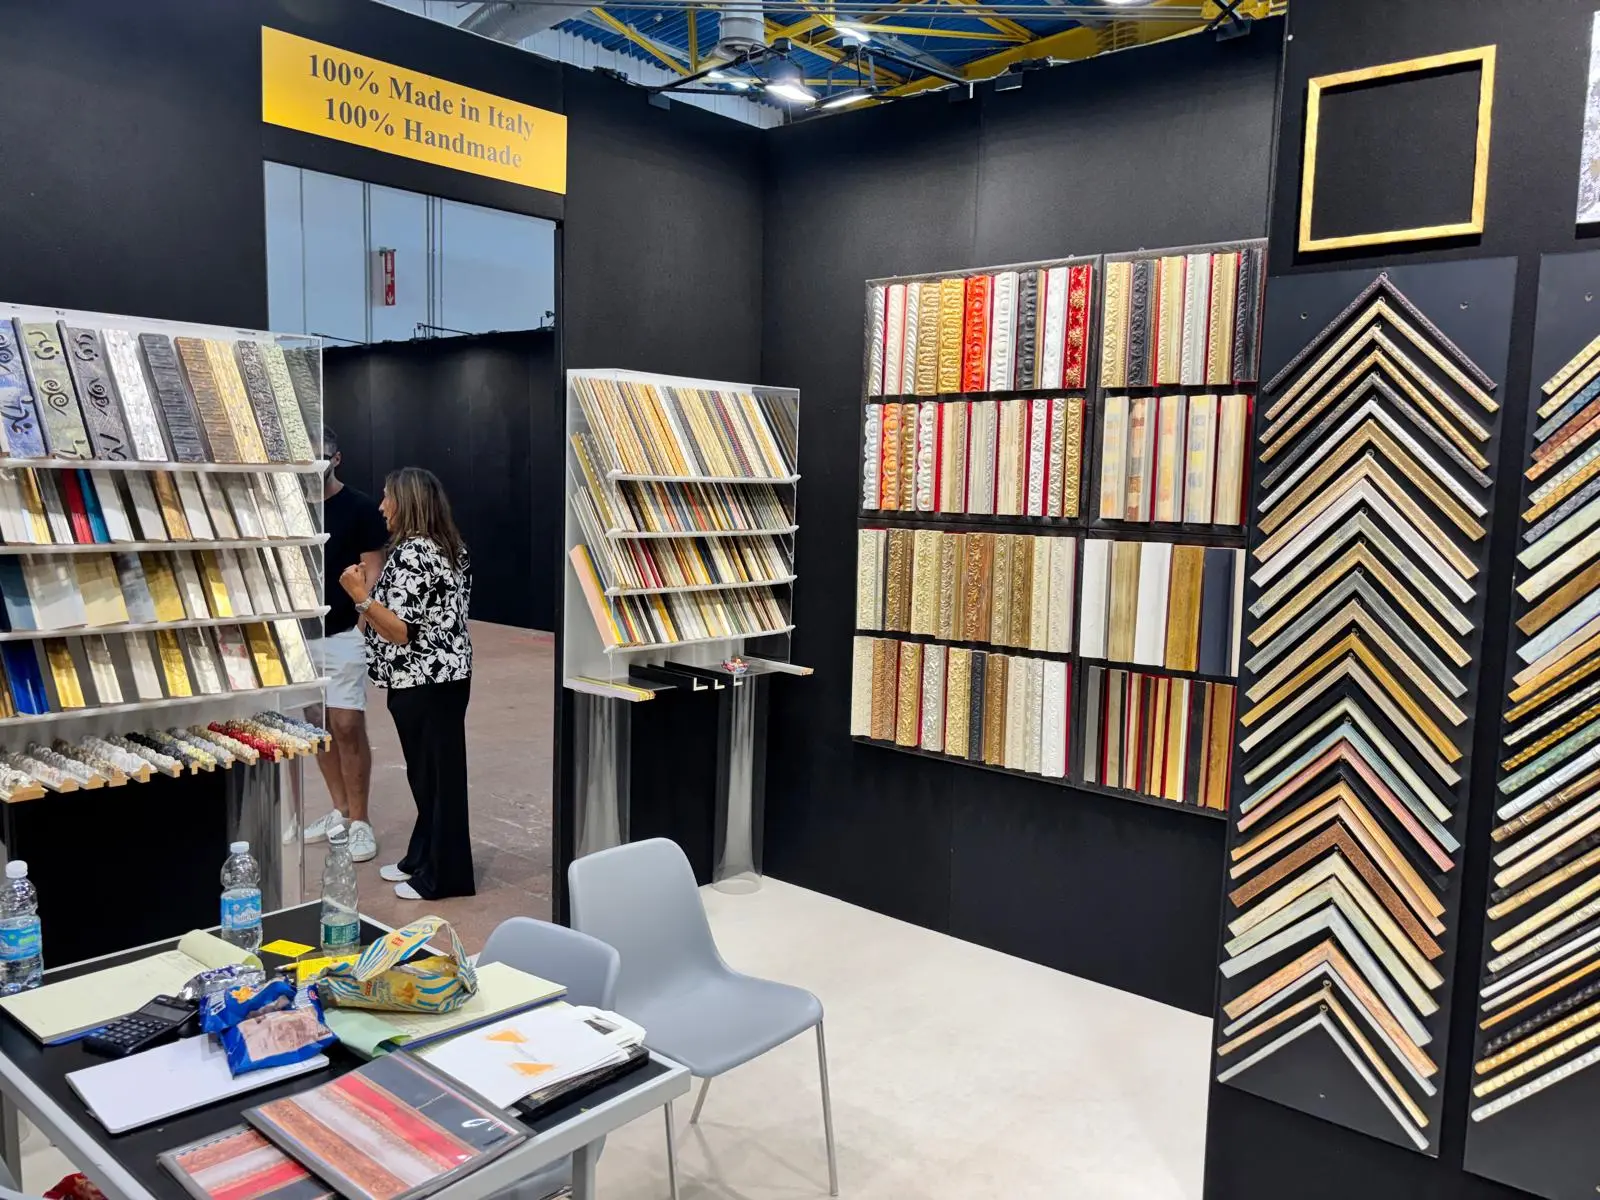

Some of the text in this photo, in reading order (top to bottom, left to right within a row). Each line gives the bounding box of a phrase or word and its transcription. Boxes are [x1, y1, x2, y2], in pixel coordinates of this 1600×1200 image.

[309, 54, 534, 141] 100% Made in Italy
[325, 98, 522, 168] 100% Handmade
